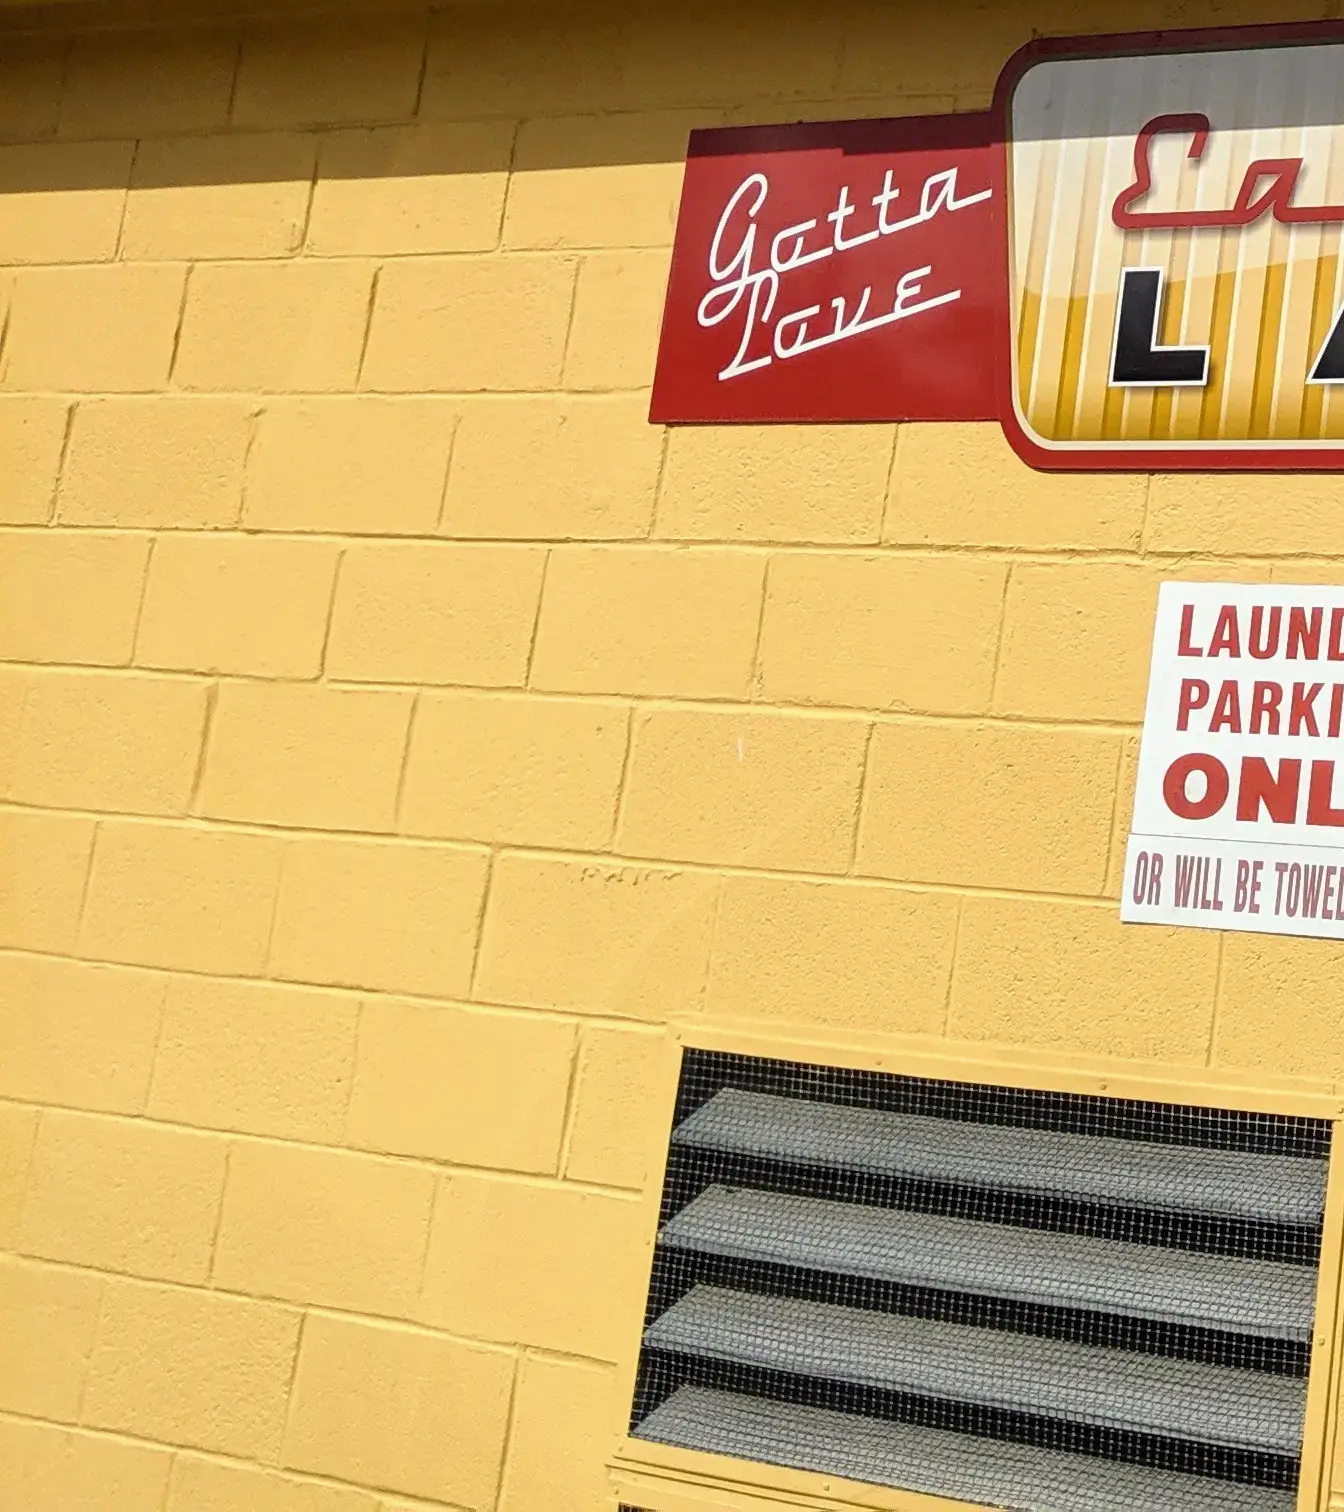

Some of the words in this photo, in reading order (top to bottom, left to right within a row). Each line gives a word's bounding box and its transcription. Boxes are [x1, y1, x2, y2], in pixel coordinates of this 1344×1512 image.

[698, 167, 992, 327] Gotta
[719, 265, 961, 381] Love
[1133, 851, 1164, 906] OR
[1174, 854, 1223, 911] WILL
[1233, 859, 1264, 914] BE
